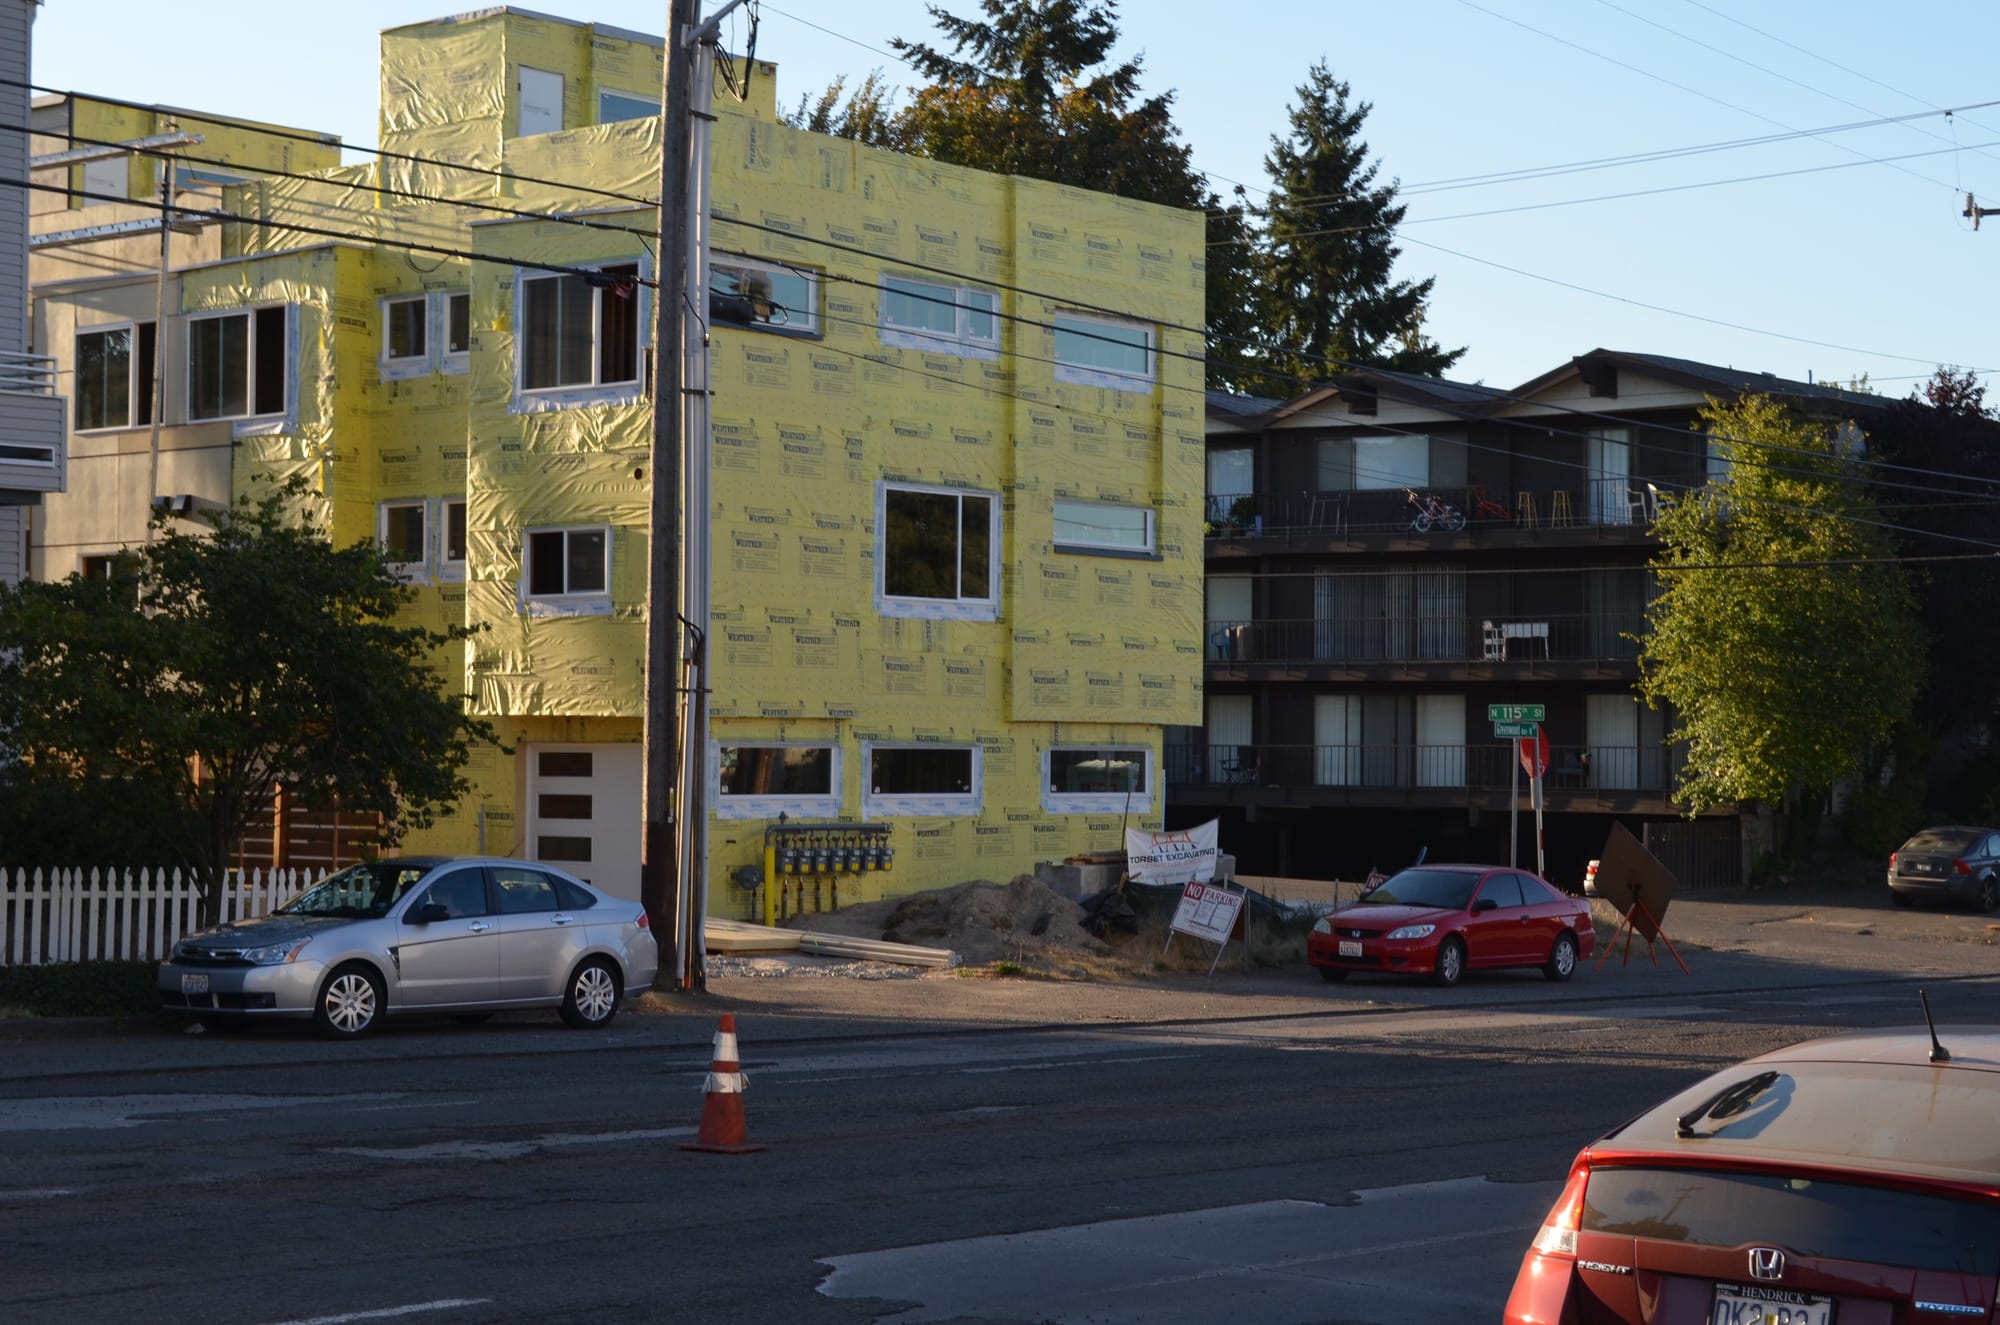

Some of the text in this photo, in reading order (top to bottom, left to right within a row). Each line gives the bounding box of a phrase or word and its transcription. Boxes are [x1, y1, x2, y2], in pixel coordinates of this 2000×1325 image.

[1491, 708, 1498, 718] N
[1166, 847, 1216, 862] EXCAVATING
[1187, 881, 1239, 908] NO PARKING
[1742, 1286, 1806, 1305] HENDRICK
[1918, 1302, 1980, 1315] HYBRID
